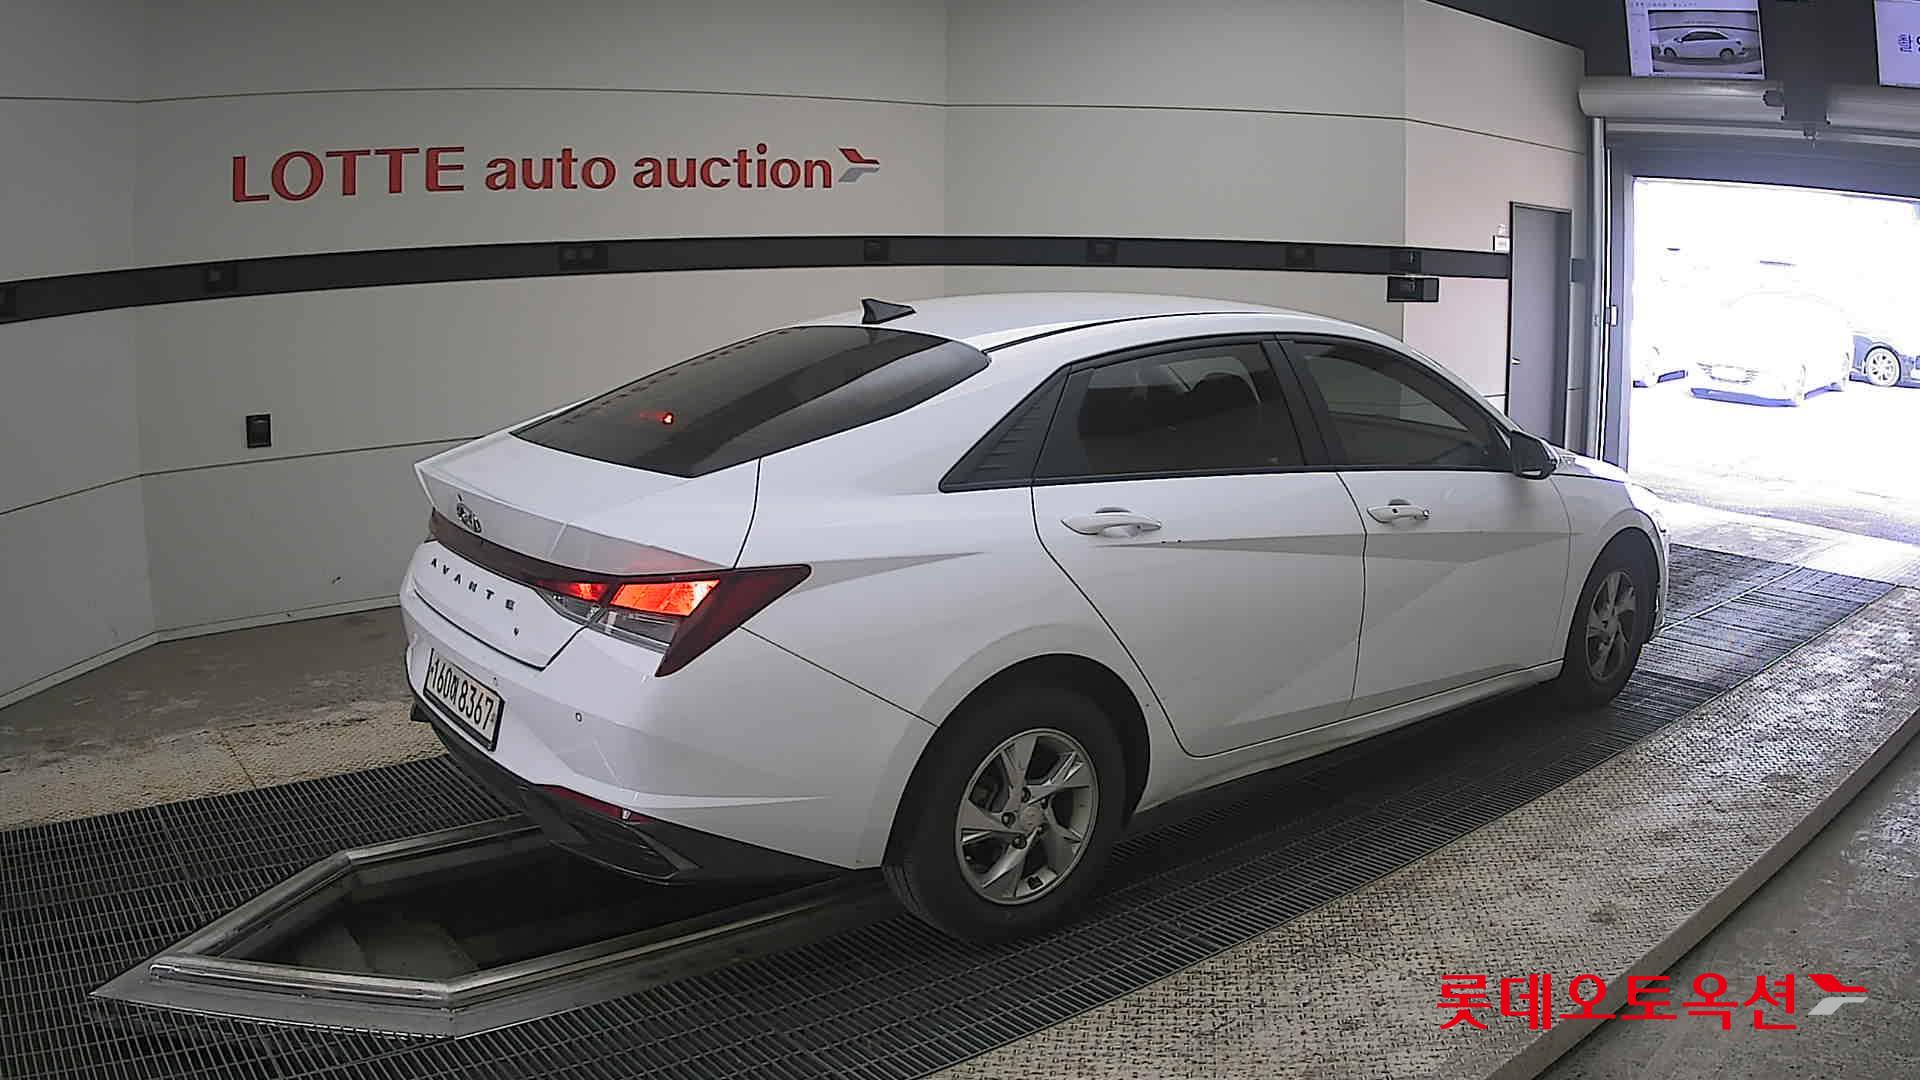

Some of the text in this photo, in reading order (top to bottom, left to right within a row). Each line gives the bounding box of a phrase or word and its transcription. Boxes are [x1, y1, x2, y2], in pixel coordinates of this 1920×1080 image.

[232, 142, 833, 203] LOTTE auto auction
[430, 557, 516, 611] AVANTE
[458, 679, 494, 731] 8367
